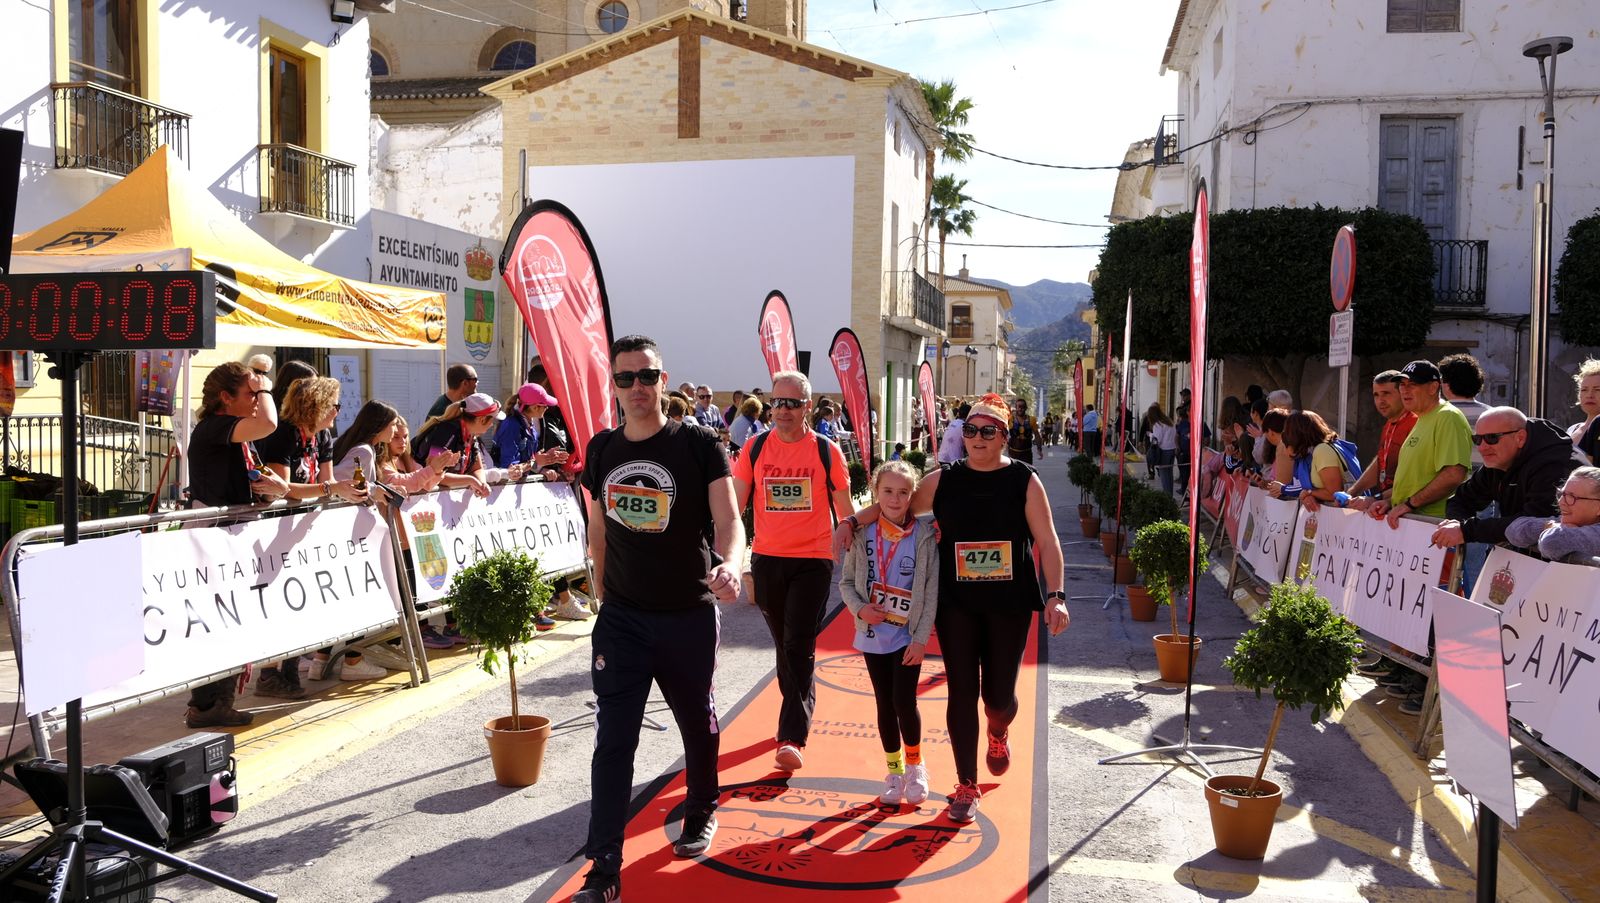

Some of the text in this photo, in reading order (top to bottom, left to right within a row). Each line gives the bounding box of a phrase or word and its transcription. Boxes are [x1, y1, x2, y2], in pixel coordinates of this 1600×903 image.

[378, 235, 460, 268] EXCELENTÍSIMO
[380, 265, 458, 293] AYUNTAMIENTO
[626, 465, 647, 474] COMBAT
[648, 467, 666, 480] SPORTS
[772, 486, 802, 497] 589
[451, 502, 570, 529] AYUNTAMIENTO DE
[616, 496, 657, 514] 483
[347, 537, 370, 557] DE
[453, 519, 578, 565] CANTORIA
[965, 550, 1001, 564] 474
[1410, 555, 1430, 575] DE
[1312, 553, 1427, 619] CANTORIA
[143, 560, 383, 646] CANTORIA
[877, 592, 911, 612] 715
[1501, 624, 1600, 712] CANT
